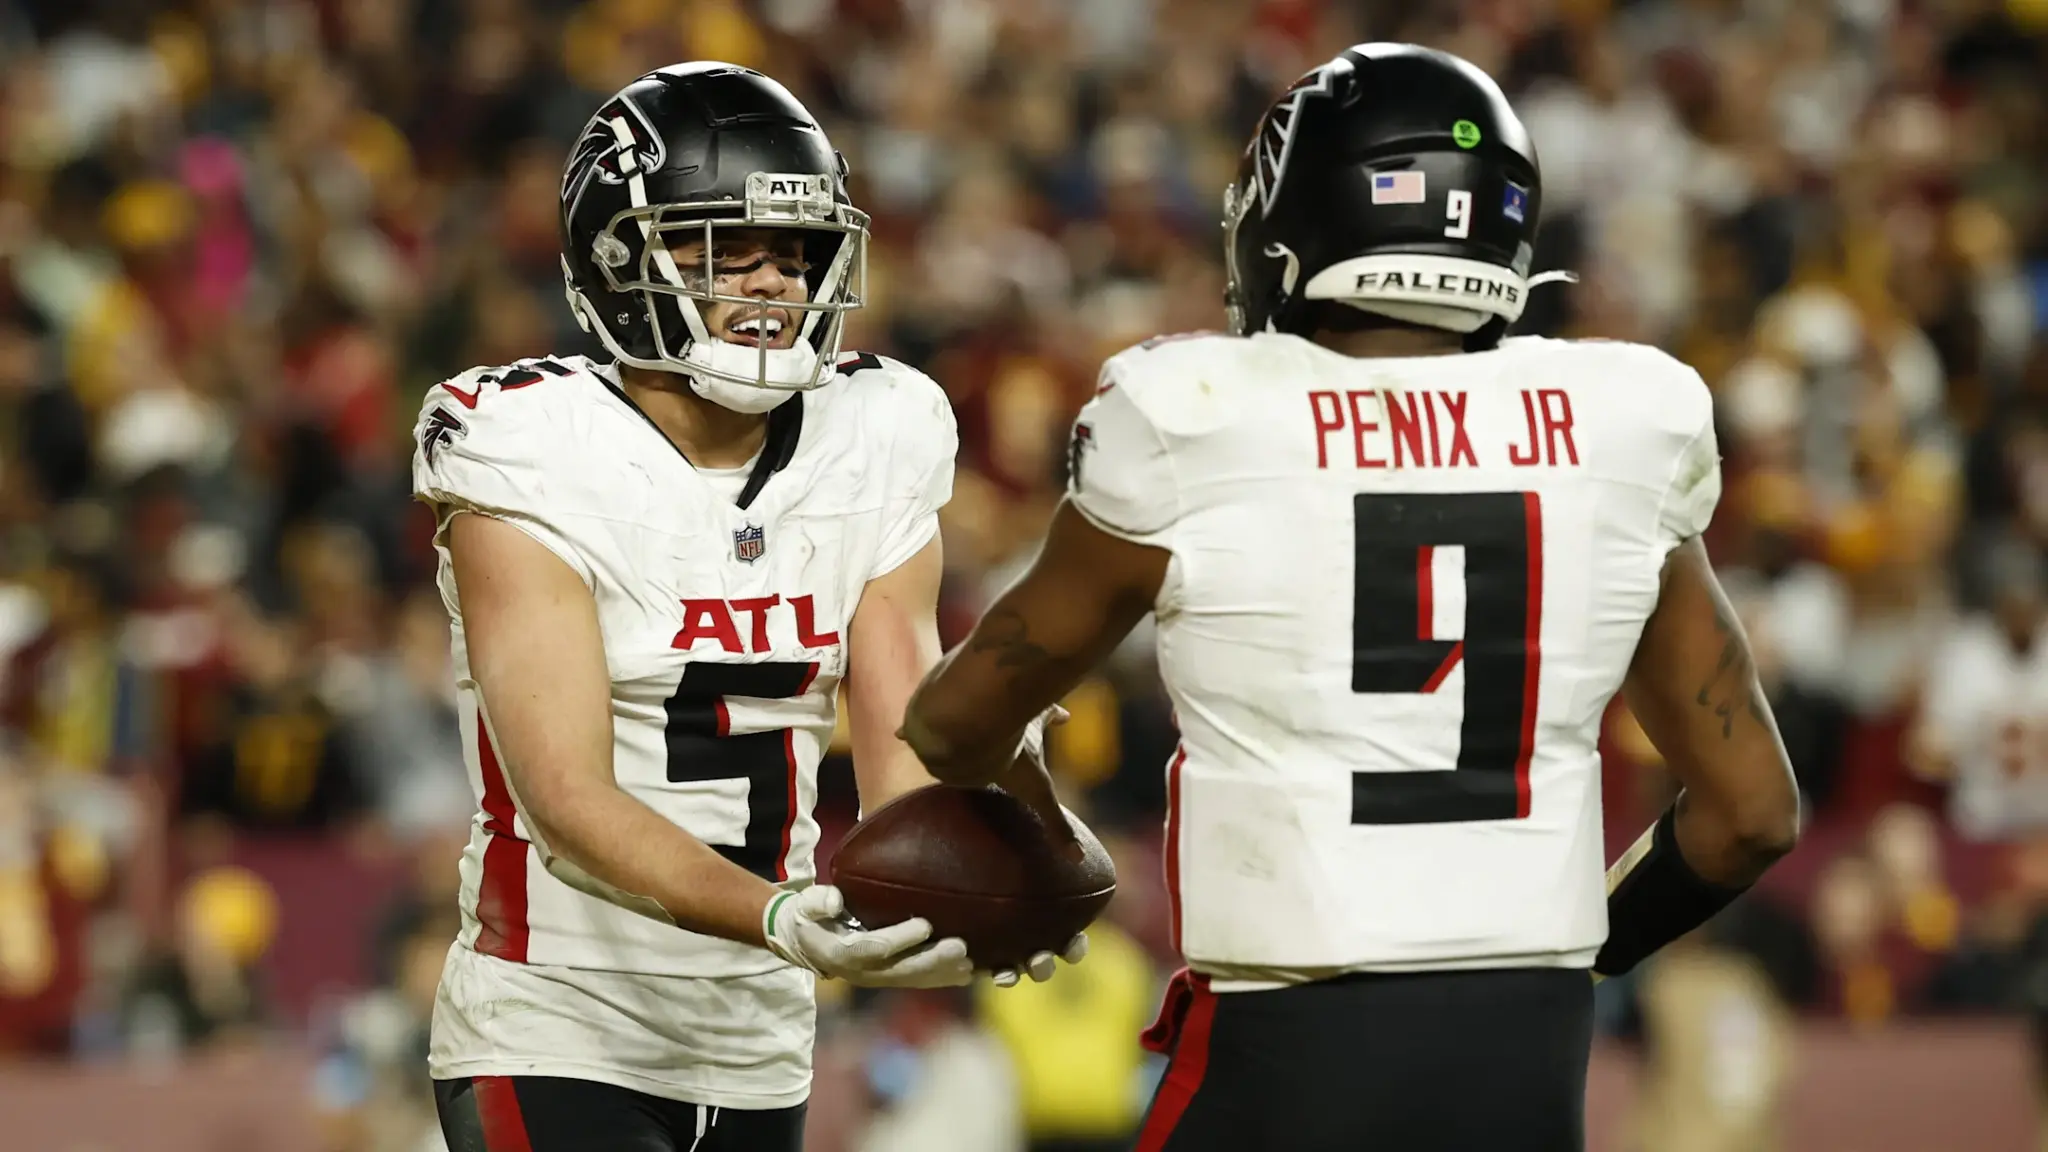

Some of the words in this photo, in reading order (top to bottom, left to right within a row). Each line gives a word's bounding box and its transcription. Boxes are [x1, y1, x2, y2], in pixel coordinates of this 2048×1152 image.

[770, 180, 811, 196] ATL
[1444, 189, 1473, 240] 9
[1355, 271, 1520, 304] FALCONS
[1307, 389, 1480, 469] PENIX
[1508, 388, 1581, 467] JR
[739, 540, 762, 558] NFL
[670, 592, 841, 654] ATL
[1350, 490, 1544, 826] 9
[663, 660, 821, 884] 5
